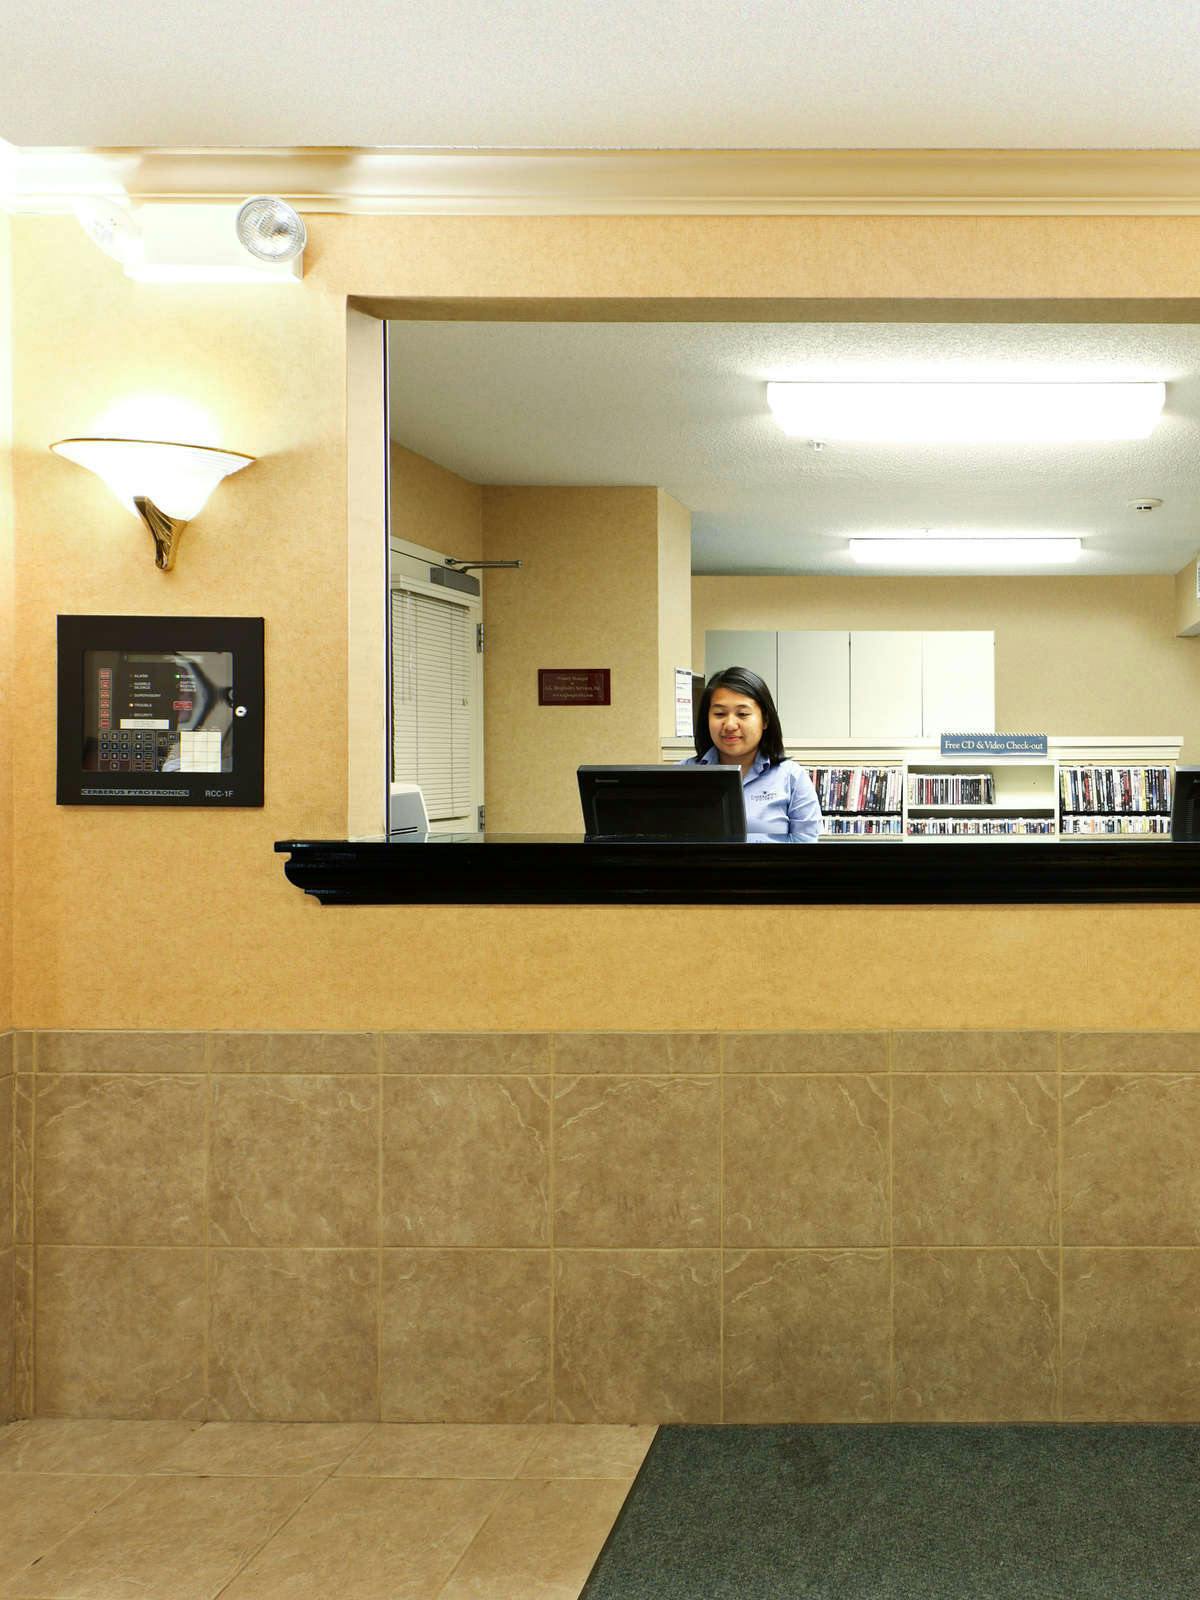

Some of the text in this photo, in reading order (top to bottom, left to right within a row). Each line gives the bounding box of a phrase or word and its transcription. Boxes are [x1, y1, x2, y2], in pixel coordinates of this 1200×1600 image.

[944, 740, 1043, 751] Free CD & Video Check-out
[81, 788, 125, 796] CERBERUS
[205, 789, 234, 798] RCC-1F
